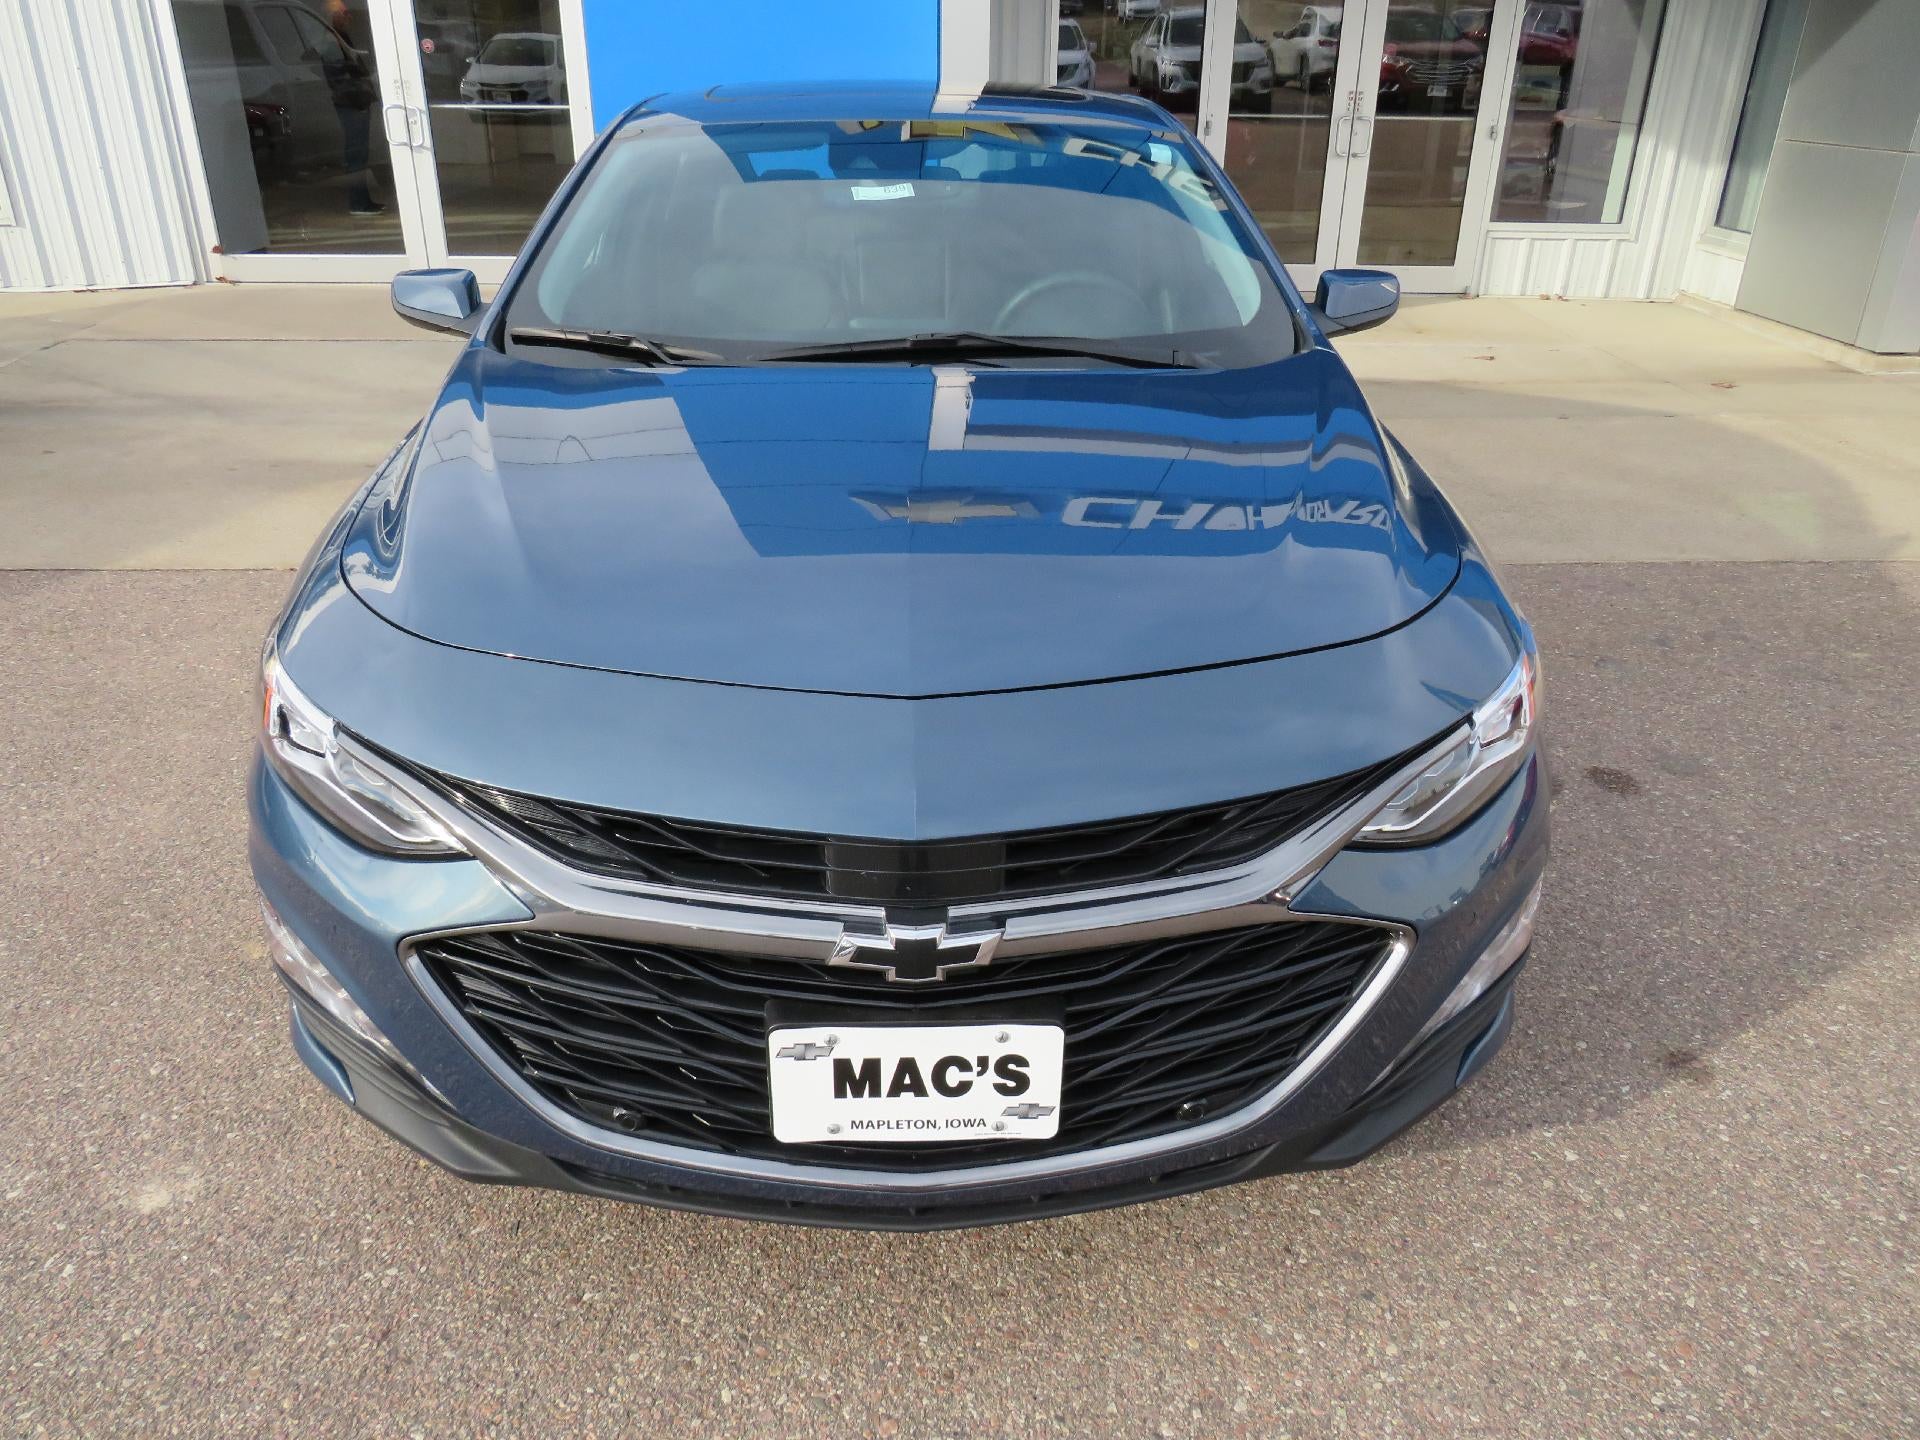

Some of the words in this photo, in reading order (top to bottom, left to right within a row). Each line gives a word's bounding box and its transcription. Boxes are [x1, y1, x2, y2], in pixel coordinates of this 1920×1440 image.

[833, 1053, 1031, 1099] MAC'S
[850, 1118, 942, 1131] MAPLETON,
[945, 1117, 987, 1129] IOWA
